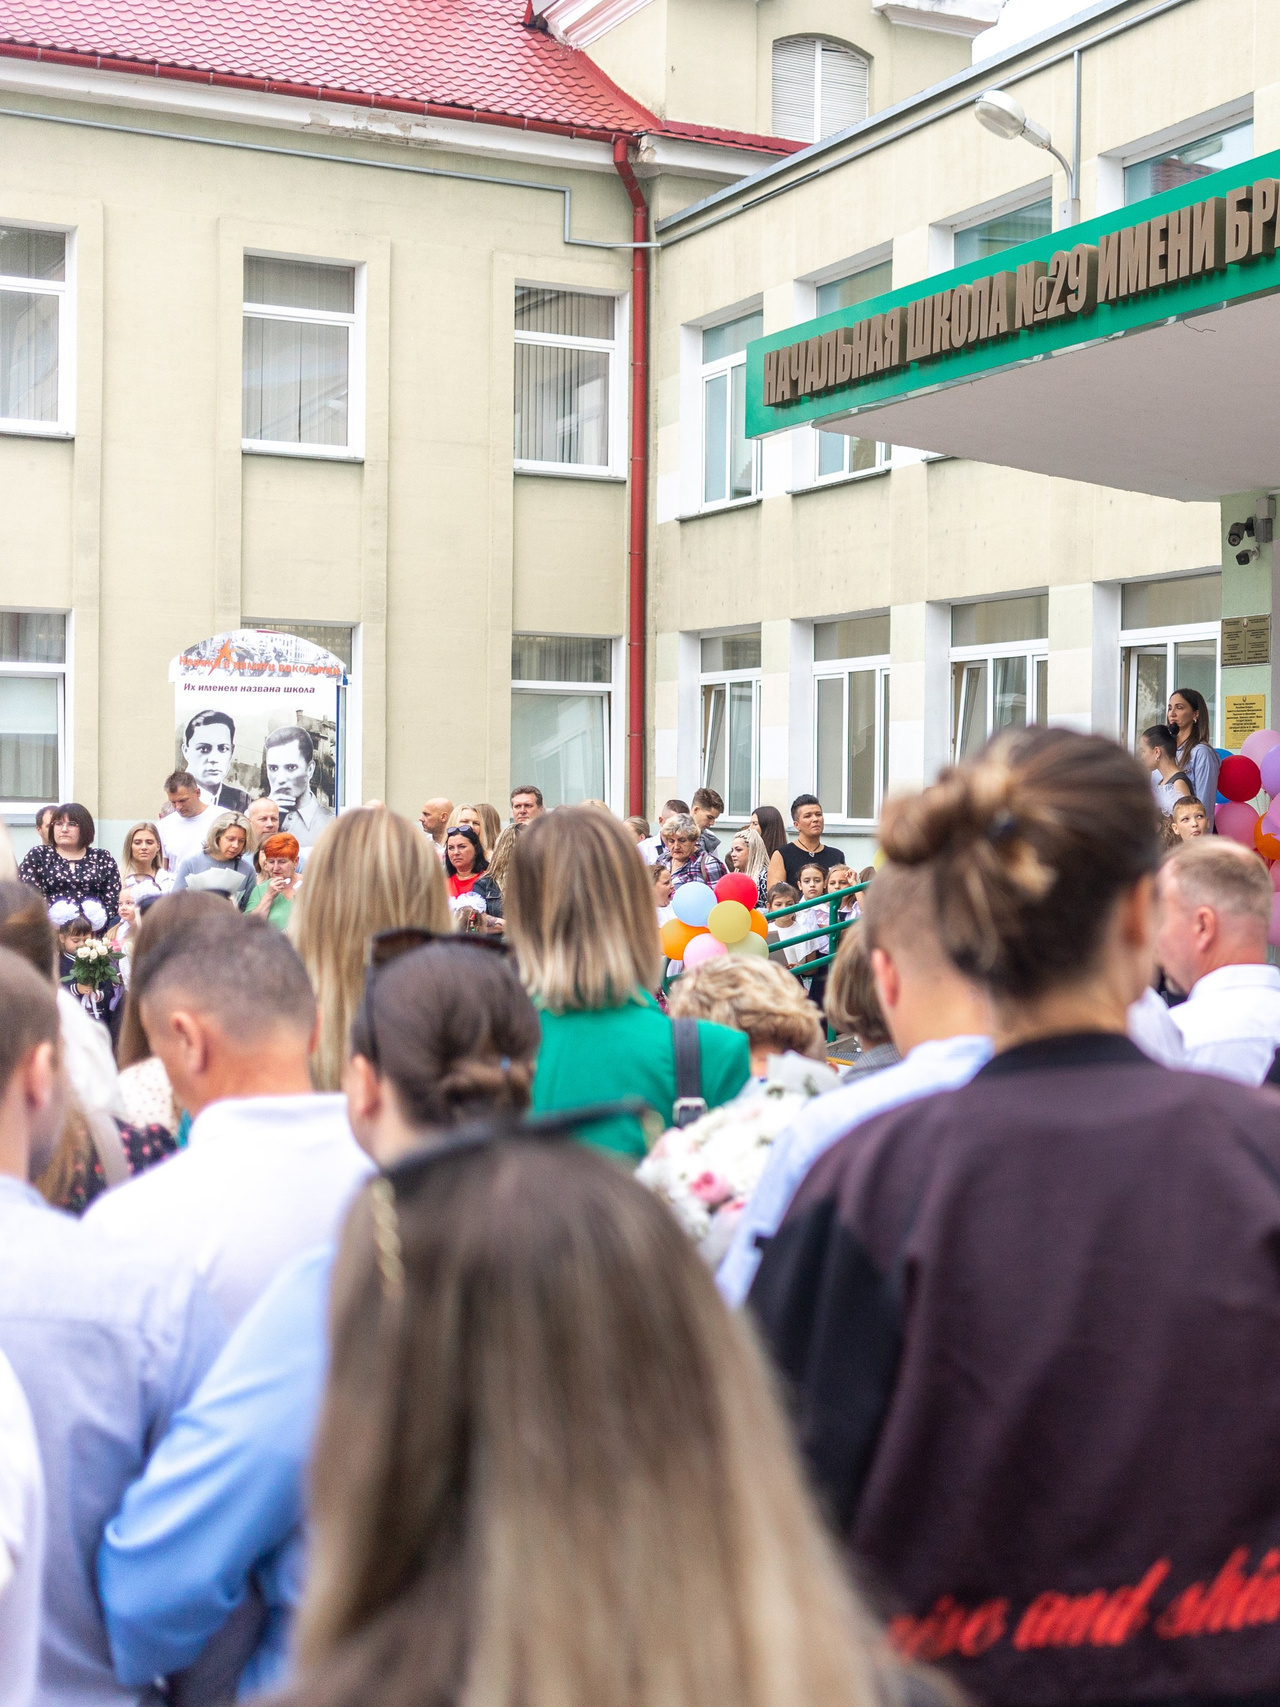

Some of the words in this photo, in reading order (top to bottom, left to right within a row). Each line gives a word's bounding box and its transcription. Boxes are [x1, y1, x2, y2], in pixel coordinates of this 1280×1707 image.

[763, 305, 908, 408] НАЧАЛЬНАЯ
[906, 270, 1016, 364] ШКОЛА
[1014, 242, 1100, 330] №29
[1097, 195, 1227, 305] ИМЕНИ
[183, 683, 196, 691] Их
[240, 685, 281, 693] названа
[283, 686, 316, 694] школа
[1012, 1556, 1172, 1651] and
